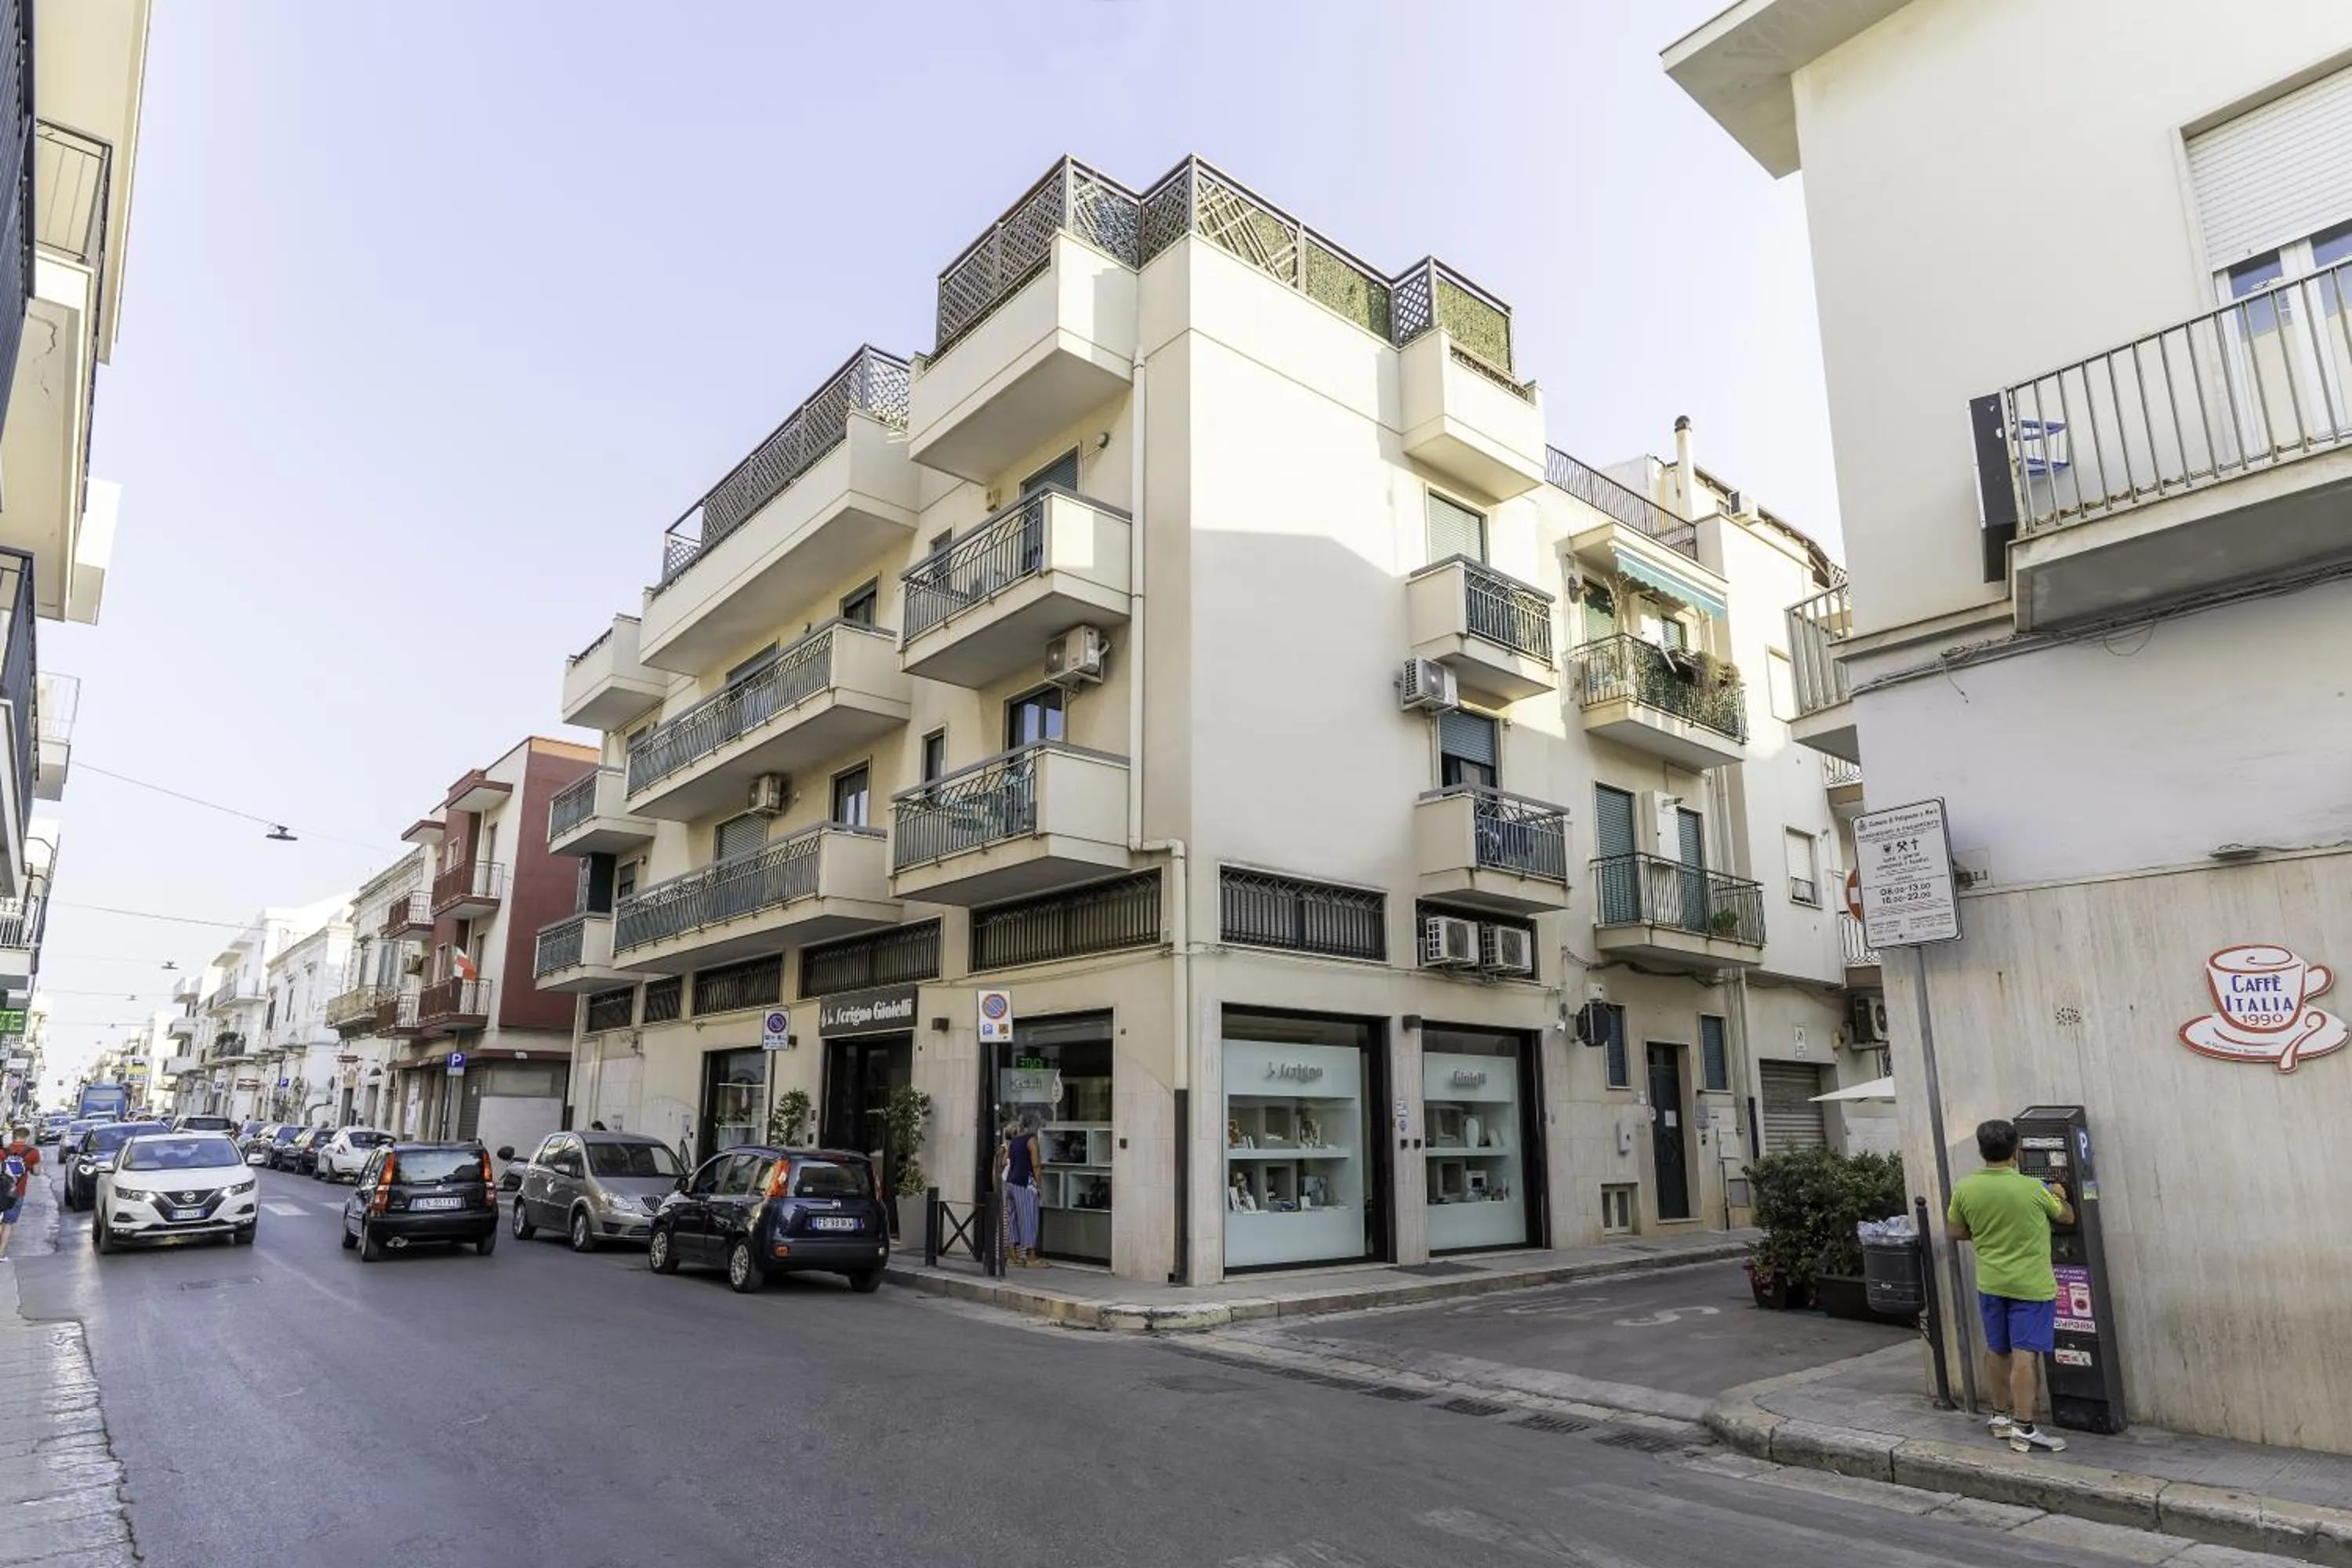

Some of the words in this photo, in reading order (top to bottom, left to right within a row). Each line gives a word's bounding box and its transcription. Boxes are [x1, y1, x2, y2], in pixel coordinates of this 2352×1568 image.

[2231, 974, 2283, 993] CAFFÈ
[2225, 994, 2295, 1012] ITALIA
[835, 1006, 873, 1027] Scrigno
[873, 998, 912, 1021] Gioielli
[2241, 1013, 2285, 1026] 1990
